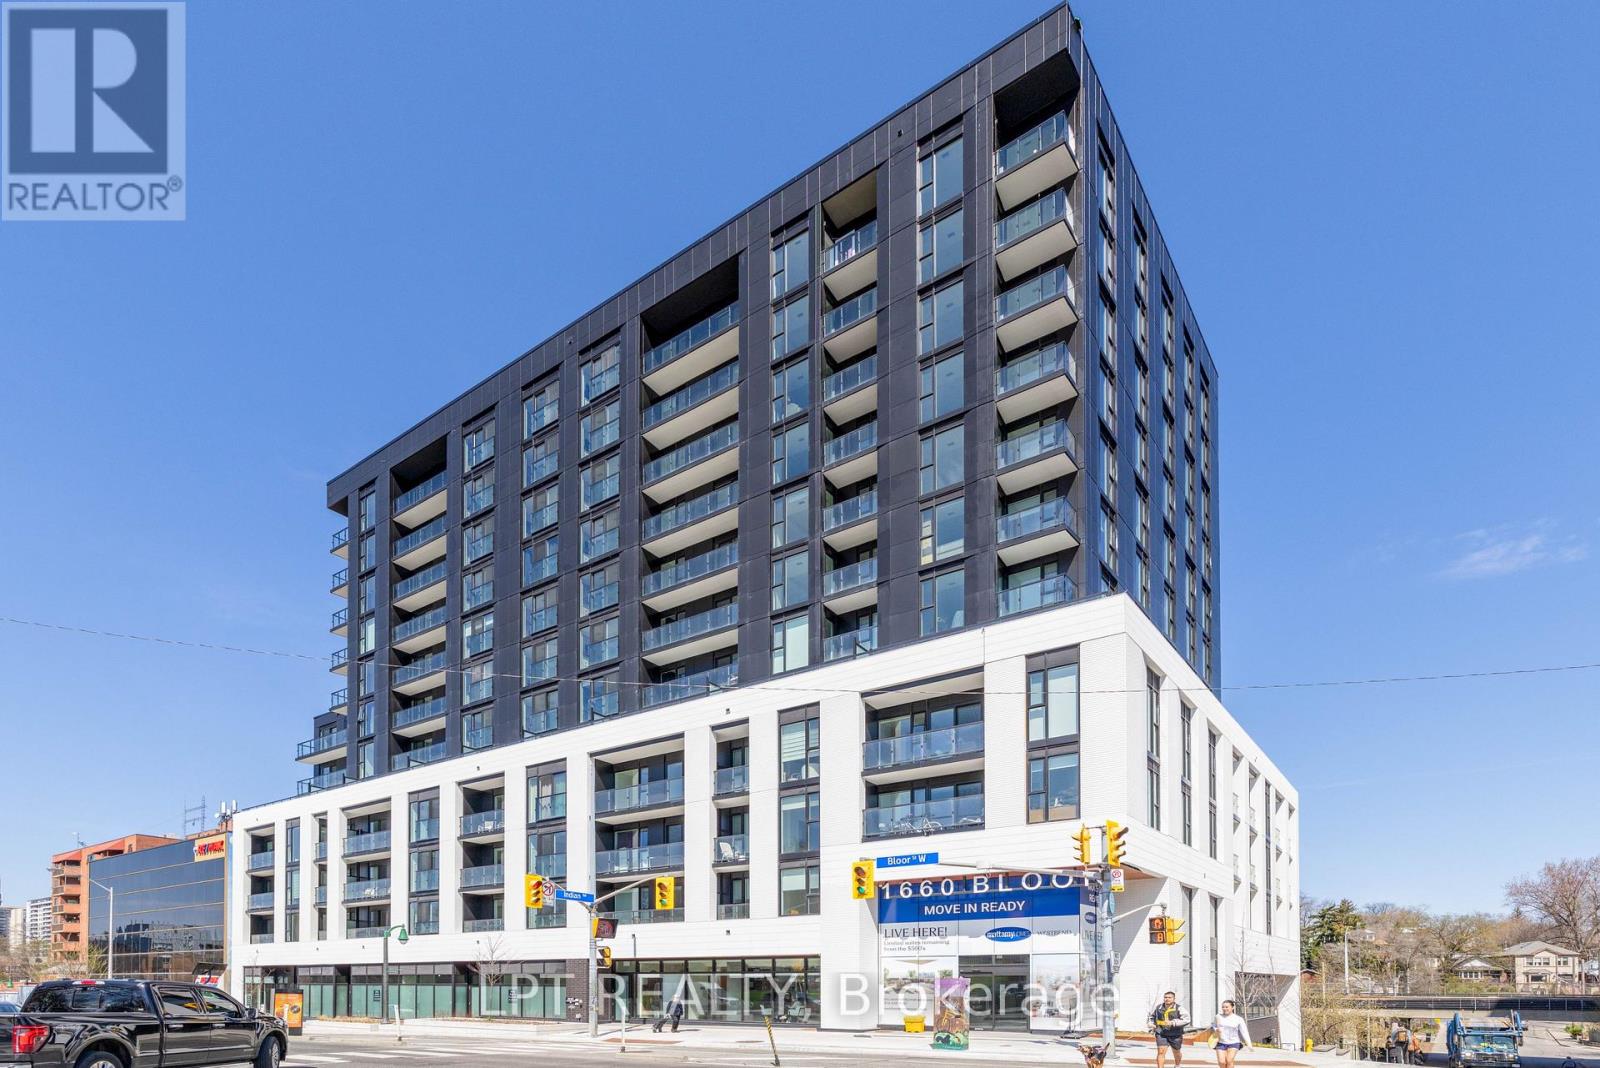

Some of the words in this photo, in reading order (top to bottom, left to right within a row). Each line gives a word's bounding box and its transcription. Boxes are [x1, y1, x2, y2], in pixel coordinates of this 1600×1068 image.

[887, 857, 911, 865] Bloor
[918, 854, 926, 863] W
[879, 879, 954, 899] 1660
[973, 872, 1089, 893] BLOO
[563, 890, 582, 899] Indian
[924, 904, 960, 915] MOVE
[964, 903, 977, 913] IN
[981, 901, 1025, 912] READY
[884, 928, 909, 938] LIVE
[912, 927, 948, 937] HERE!
